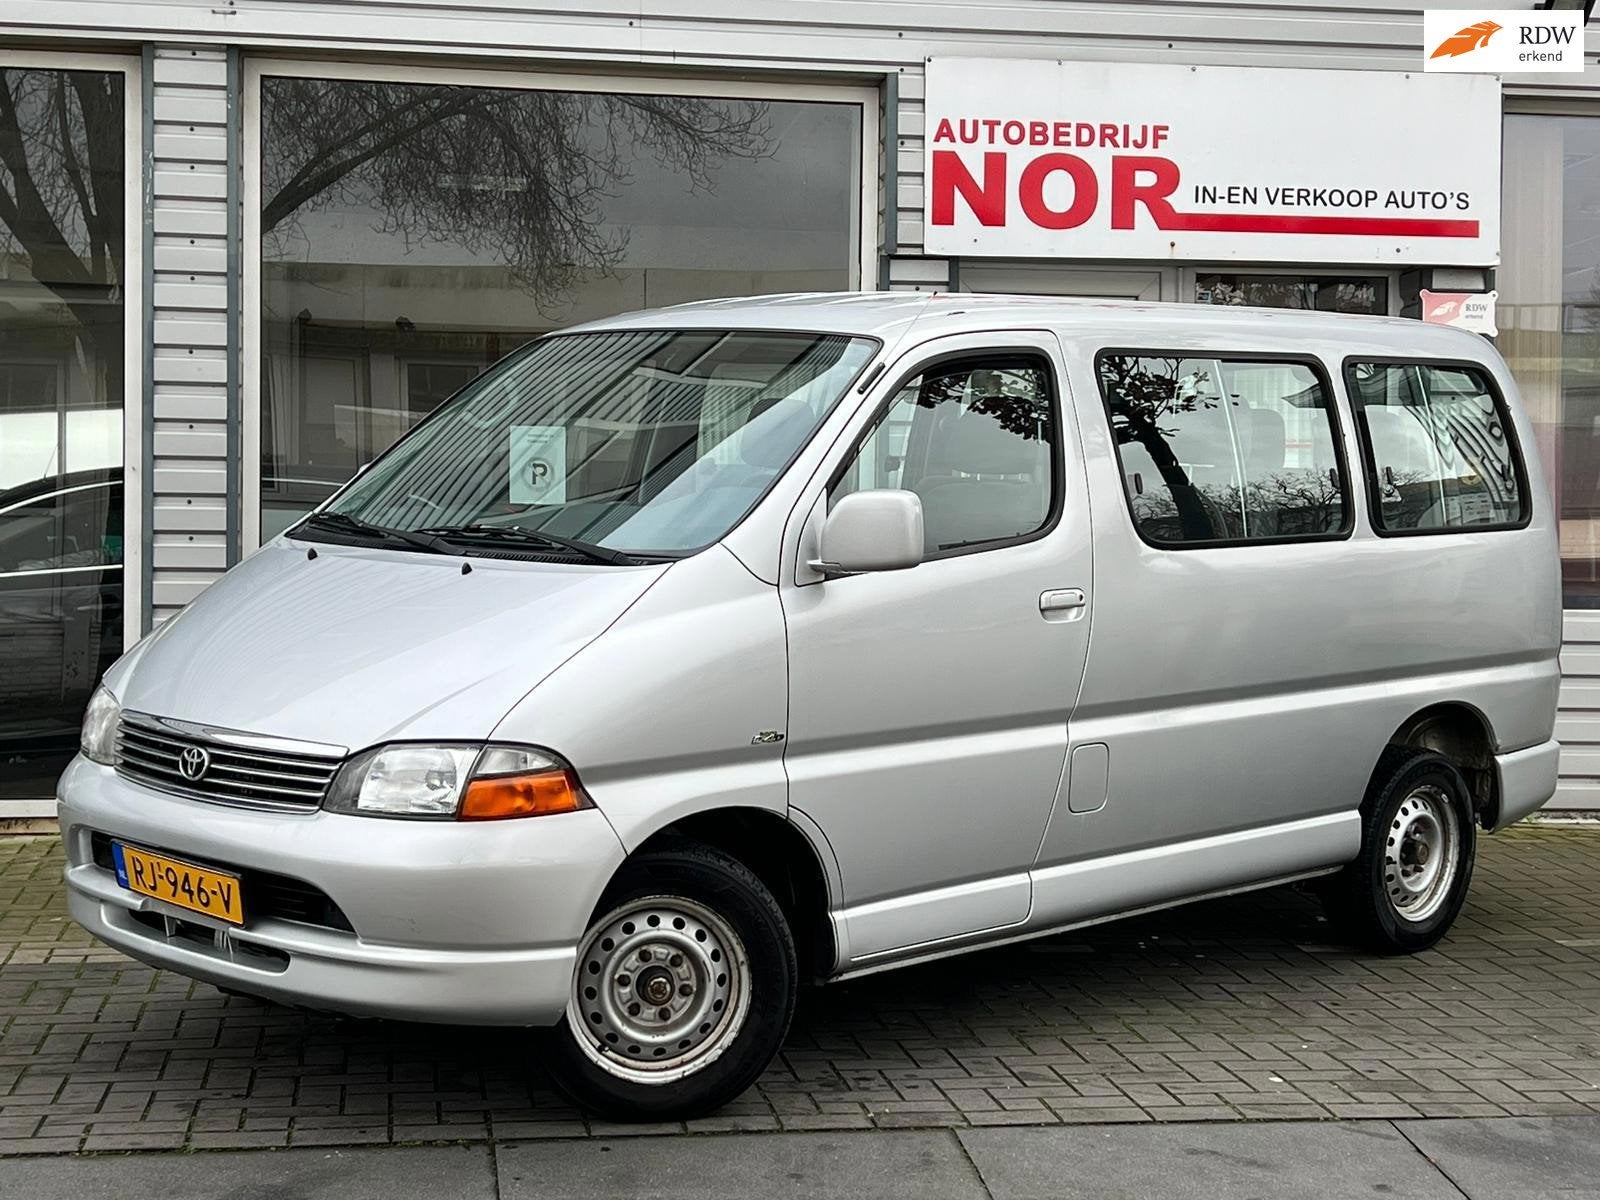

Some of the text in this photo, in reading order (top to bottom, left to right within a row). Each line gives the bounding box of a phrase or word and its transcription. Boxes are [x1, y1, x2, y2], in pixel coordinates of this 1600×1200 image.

[933, 118, 1170, 149] AUTOBEDRIJF
[931, 150, 1181, 231] NOR
[1194, 185, 1258, 205] IN-EN
[1265, 187, 1378, 208] VERKOOP
[1465, 303, 1488, 312] RDW
